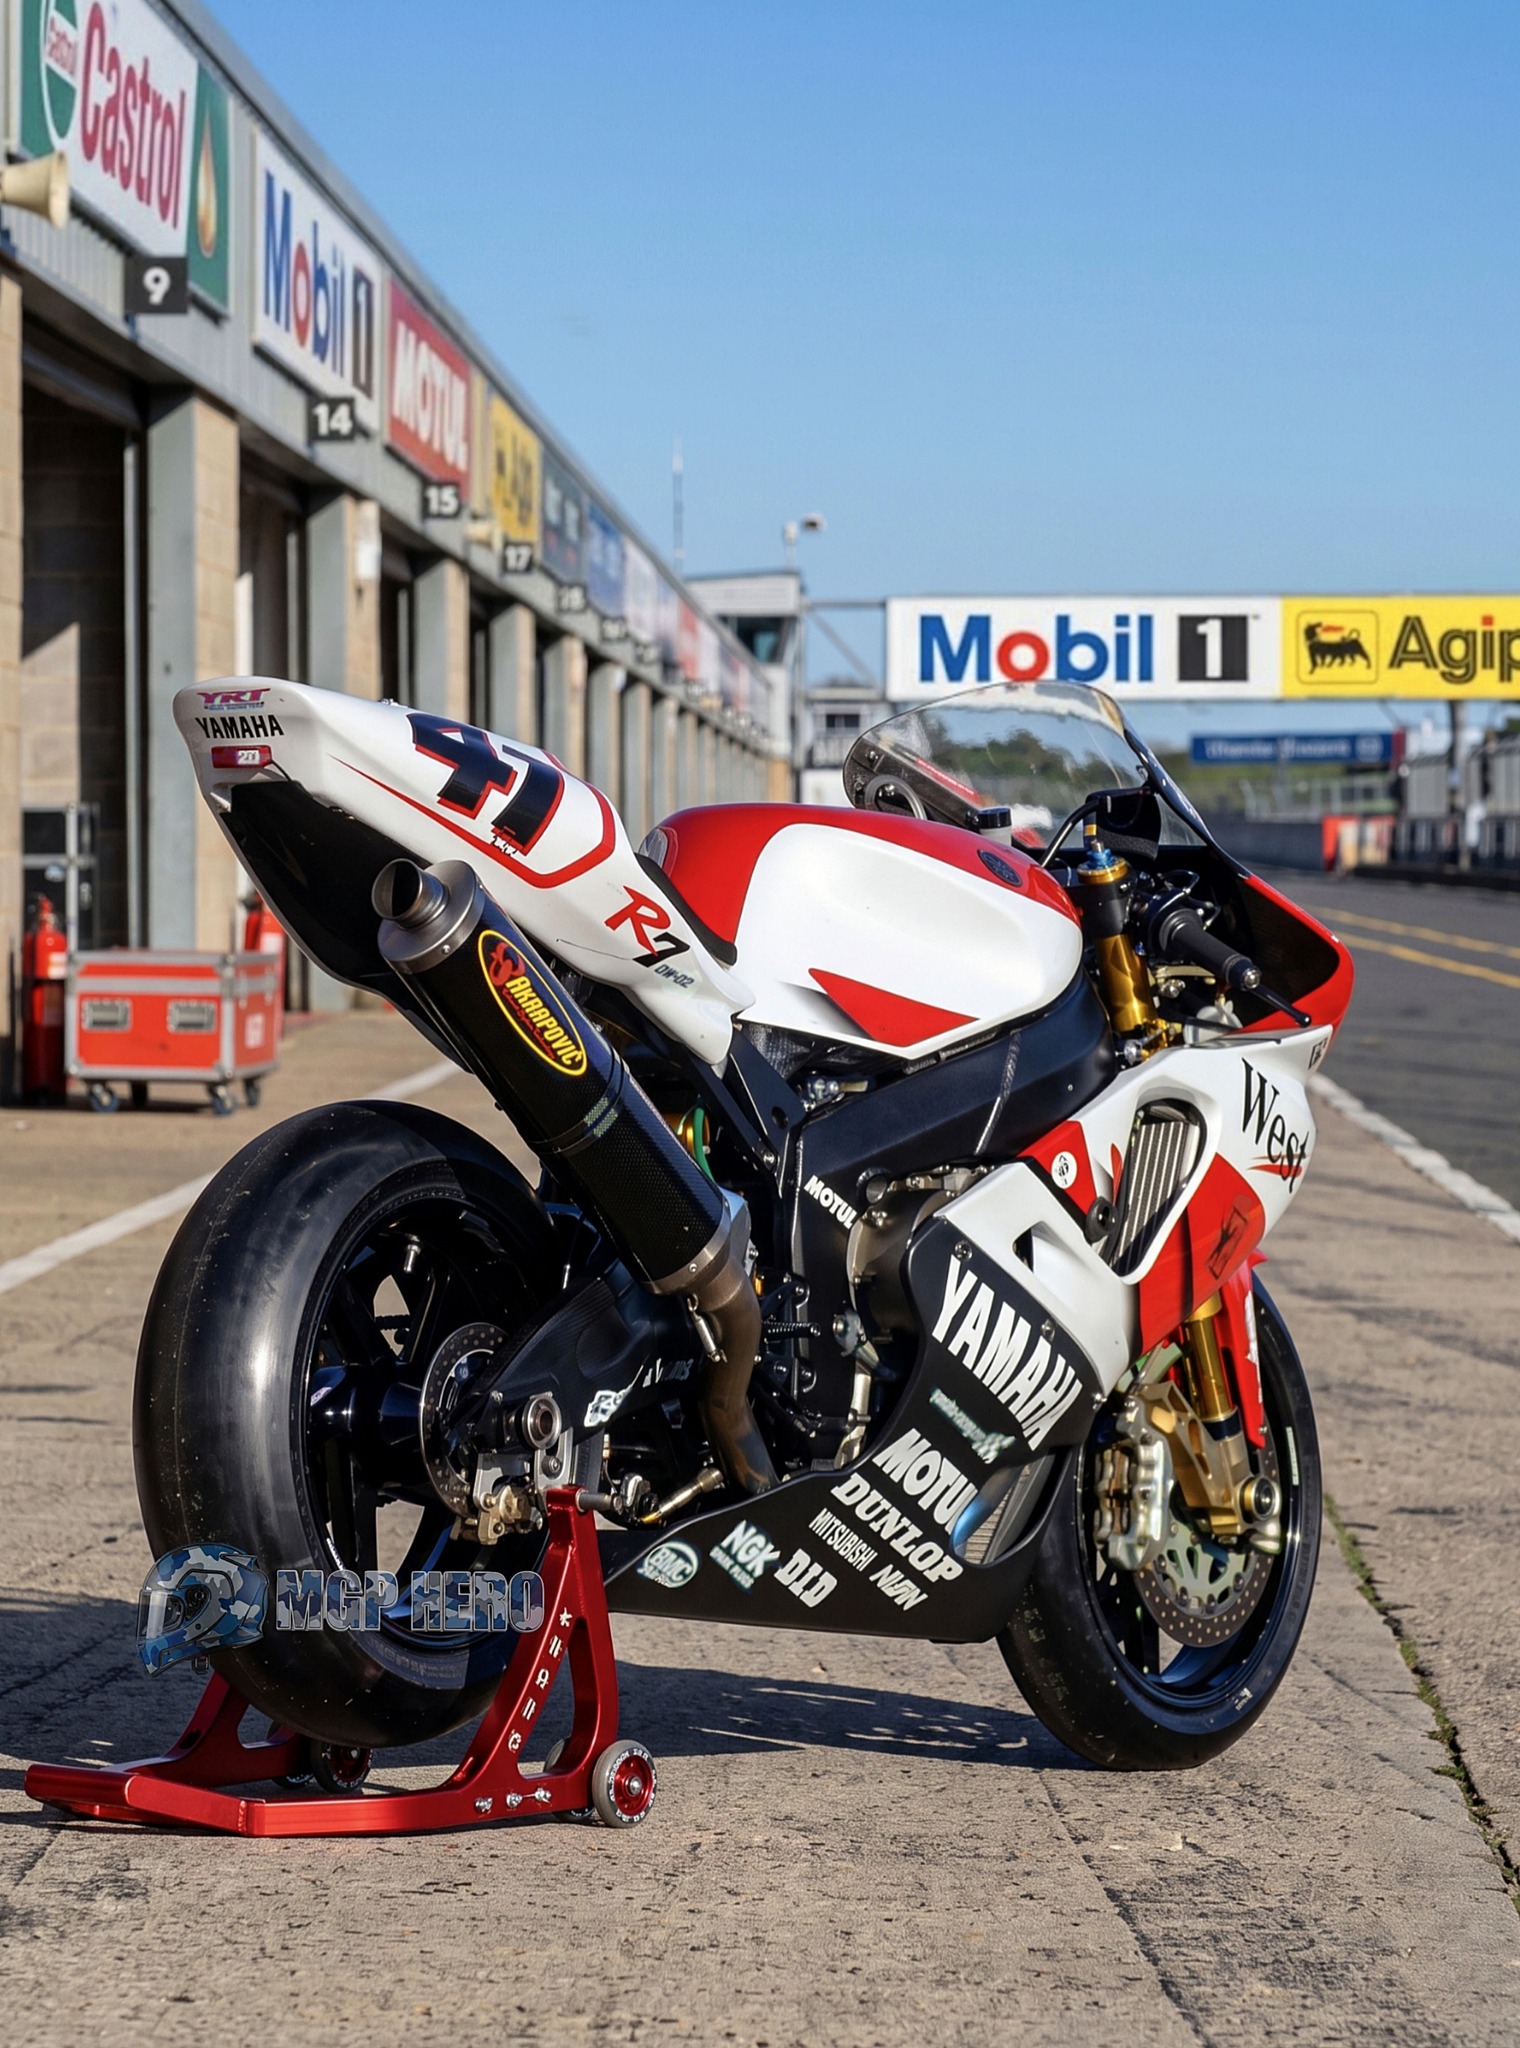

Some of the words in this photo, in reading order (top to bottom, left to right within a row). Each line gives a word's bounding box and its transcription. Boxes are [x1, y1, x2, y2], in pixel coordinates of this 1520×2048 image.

[81, 2, 185, 229] Castrol
[143, 267, 171, 304] 9
[264, 168, 345, 378] Mobil
[313, 403, 353, 436] 14
[393, 320, 467, 473] MOTUL
[425, 485, 459, 516] 15
[505, 545, 532, 571] 17
[919, 614, 1154, 683] Mobil
[195, 714, 284, 739] YAMAHA
[197, 688, 271, 704] YRT
[406, 713, 565, 857] 41
[604, 885, 690, 968] R7
[1242, 1057, 1310, 1194] West
[803, 1174, 858, 1230] MOTUL
[931, 1253, 1083, 1451] YAMAHA
[720, 1519, 781, 1578] NGK
[808, 1508, 878, 1572] MITSUBISHI
[830, 1472, 964, 1583] DUNLOP
[649, 1546, 693, 1582] BMC
[774, 1548, 838, 1608] DID
